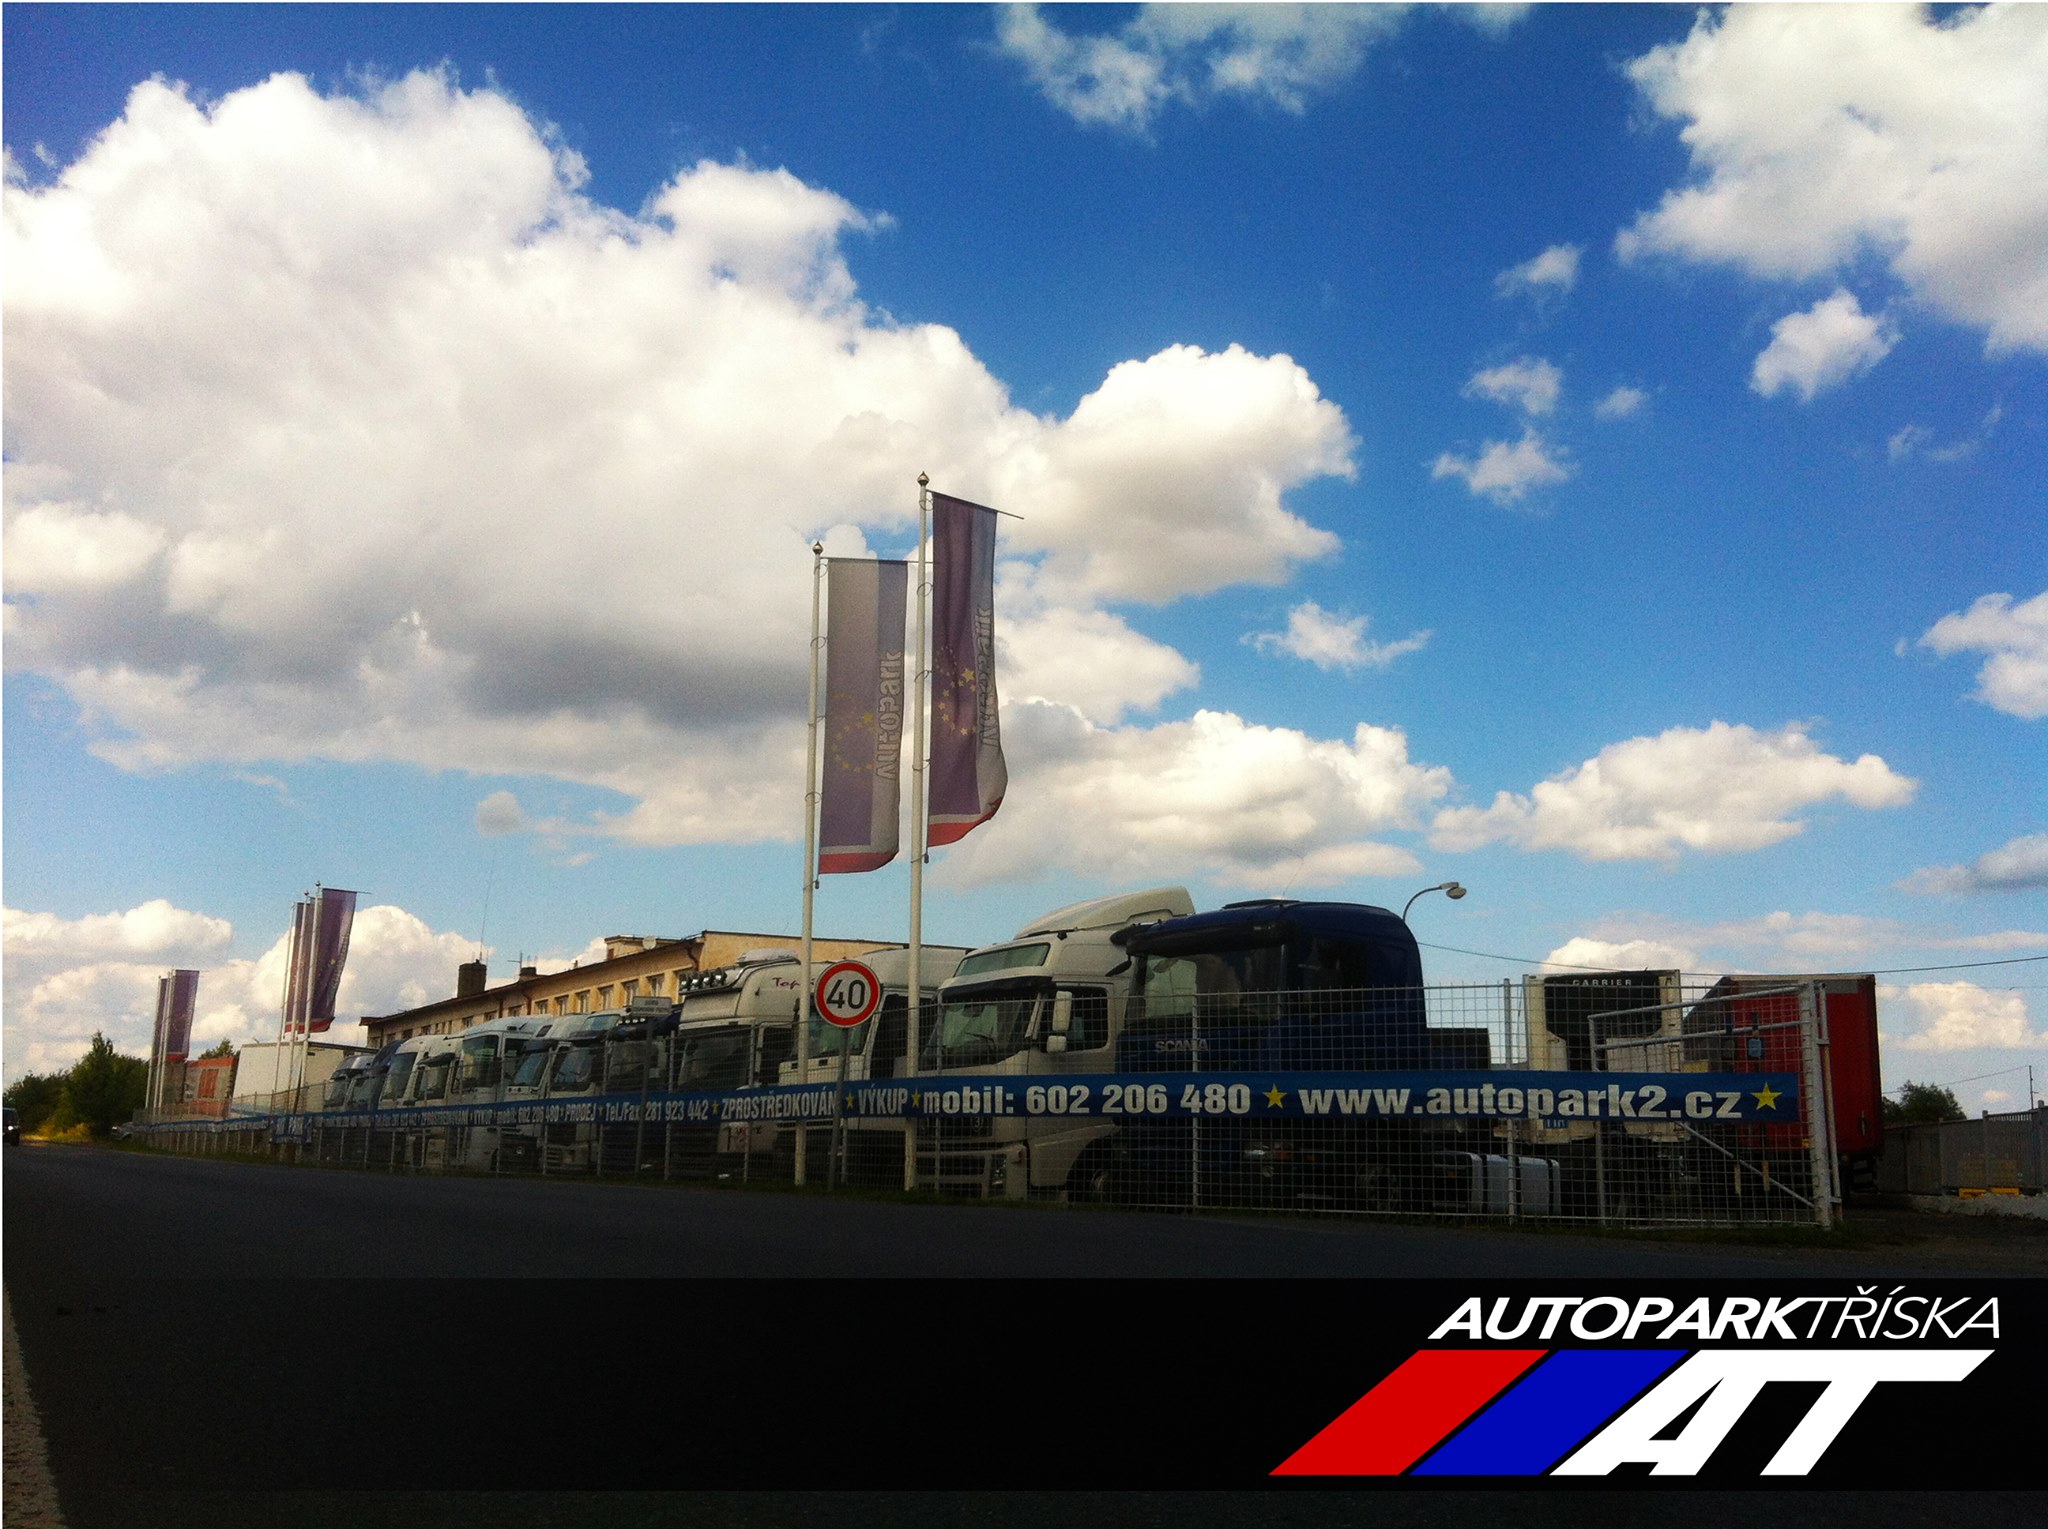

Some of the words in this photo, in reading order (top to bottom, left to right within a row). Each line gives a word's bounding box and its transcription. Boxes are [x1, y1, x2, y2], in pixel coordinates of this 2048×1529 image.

[1572, 979, 1632, 987] CARRIER
[827, 979, 866, 1009] 40
[1155, 1039, 1209, 1052] SCANA
[644, 1101, 662, 1121] 281
[665, 1100, 685, 1121] 923
[687, 1099, 709, 1121] 442
[720, 1086, 840, 1120] ZPROSTŘEDKOVÁN
[857, 1083, 908, 1115] VÝKUP
[923, 1085, 1014, 1114] mobil:
[1026, 1085, 1090, 1114] 602
[1101, 1084, 1168, 1114] 206
[1179, 1083, 1251, 1114] 480
[1298, 1083, 1742, 1119] www.autopark2.cz
